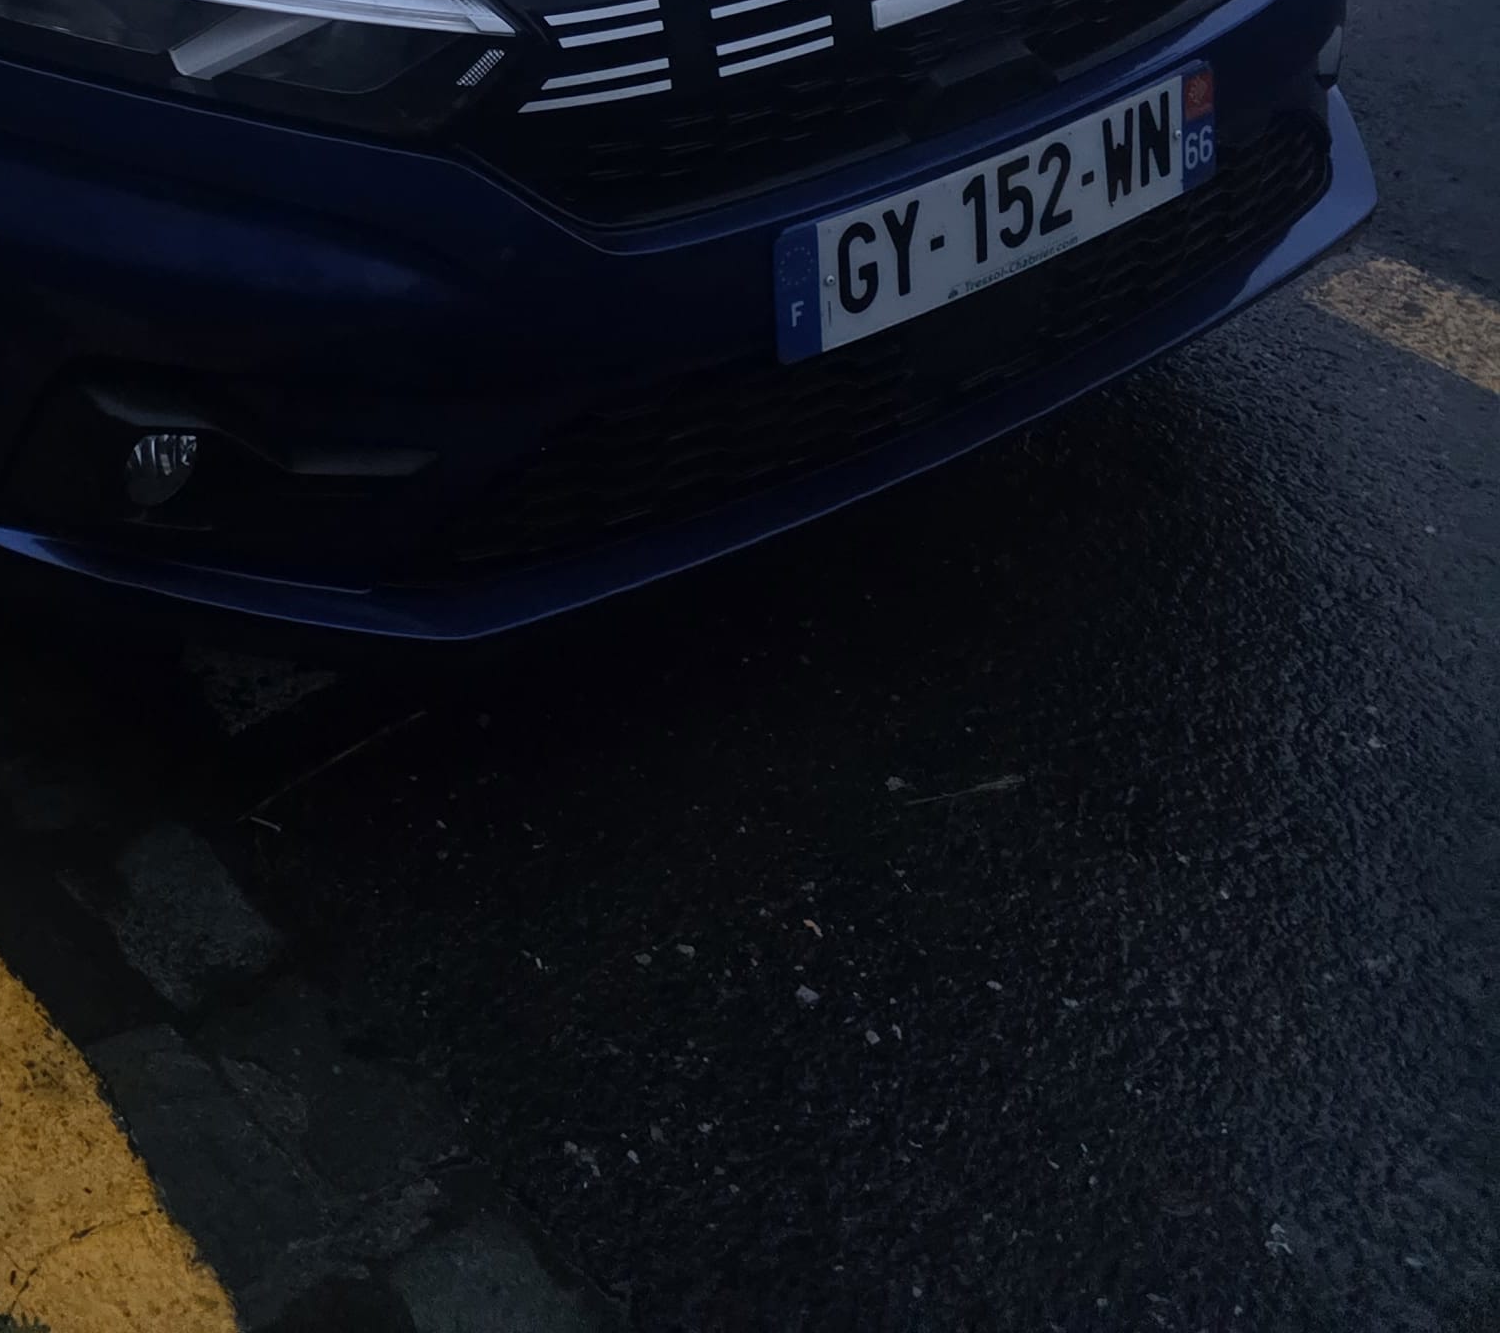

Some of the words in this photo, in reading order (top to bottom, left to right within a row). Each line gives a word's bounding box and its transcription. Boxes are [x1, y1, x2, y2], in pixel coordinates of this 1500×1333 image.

[1184, 124, 1214, 170] 66
[837, 90, 1171, 315] GY-152-WN
[790, 300, 805, 328] F
